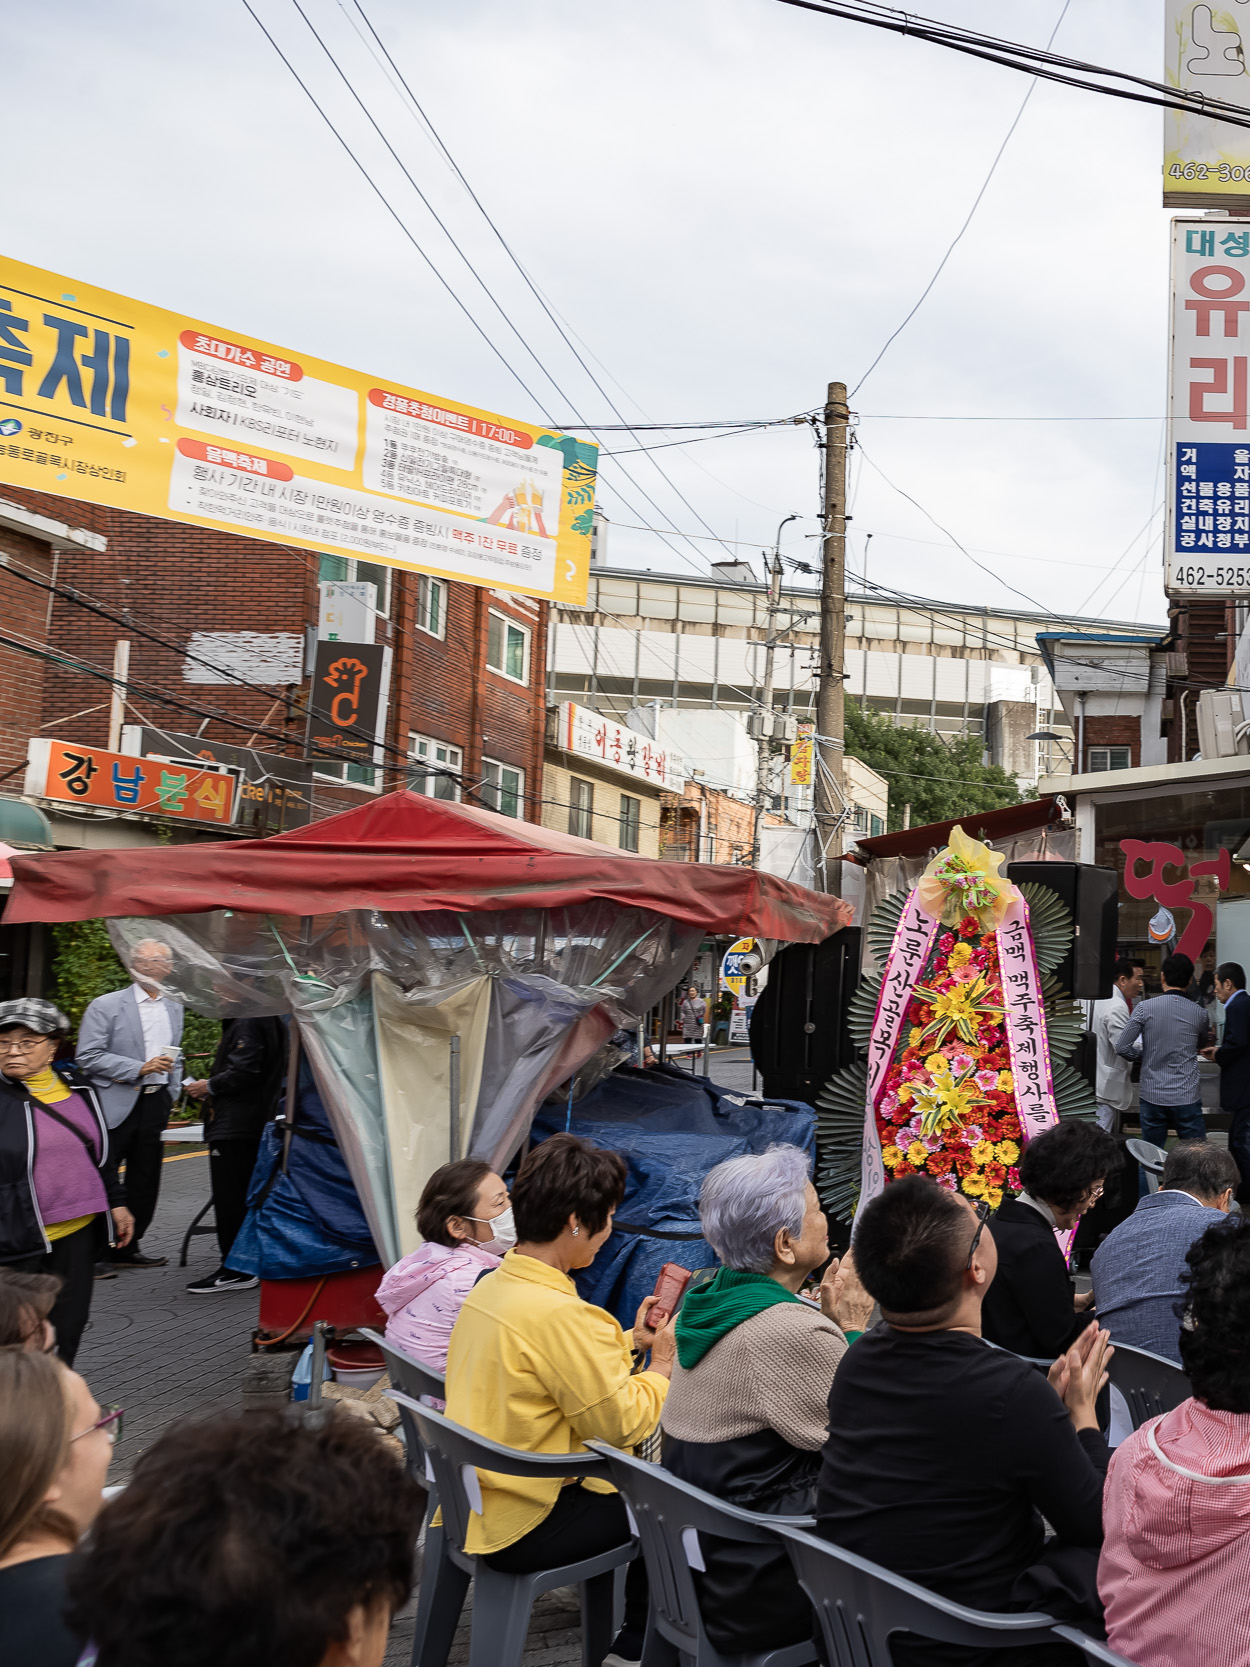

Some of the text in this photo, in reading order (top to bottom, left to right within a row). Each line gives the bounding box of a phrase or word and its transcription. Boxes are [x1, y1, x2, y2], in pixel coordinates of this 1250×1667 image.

[1185, 230, 1250, 258] 대성
[1184, 264, 1250, 430] 유리
[259, 354, 292, 379] 공연
[27, 427, 74, 447] 광진구
[480, 422, 522, 445] 17:00~
[226, 473, 260, 494] 기간
[261, 480, 277, 497] 내
[279, 486, 309, 506] 시장
[1180, 498, 1250, 515] 건축유리
[58, 750, 227, 820] 강남분식
[1119, 838, 1231, 965] 떡
